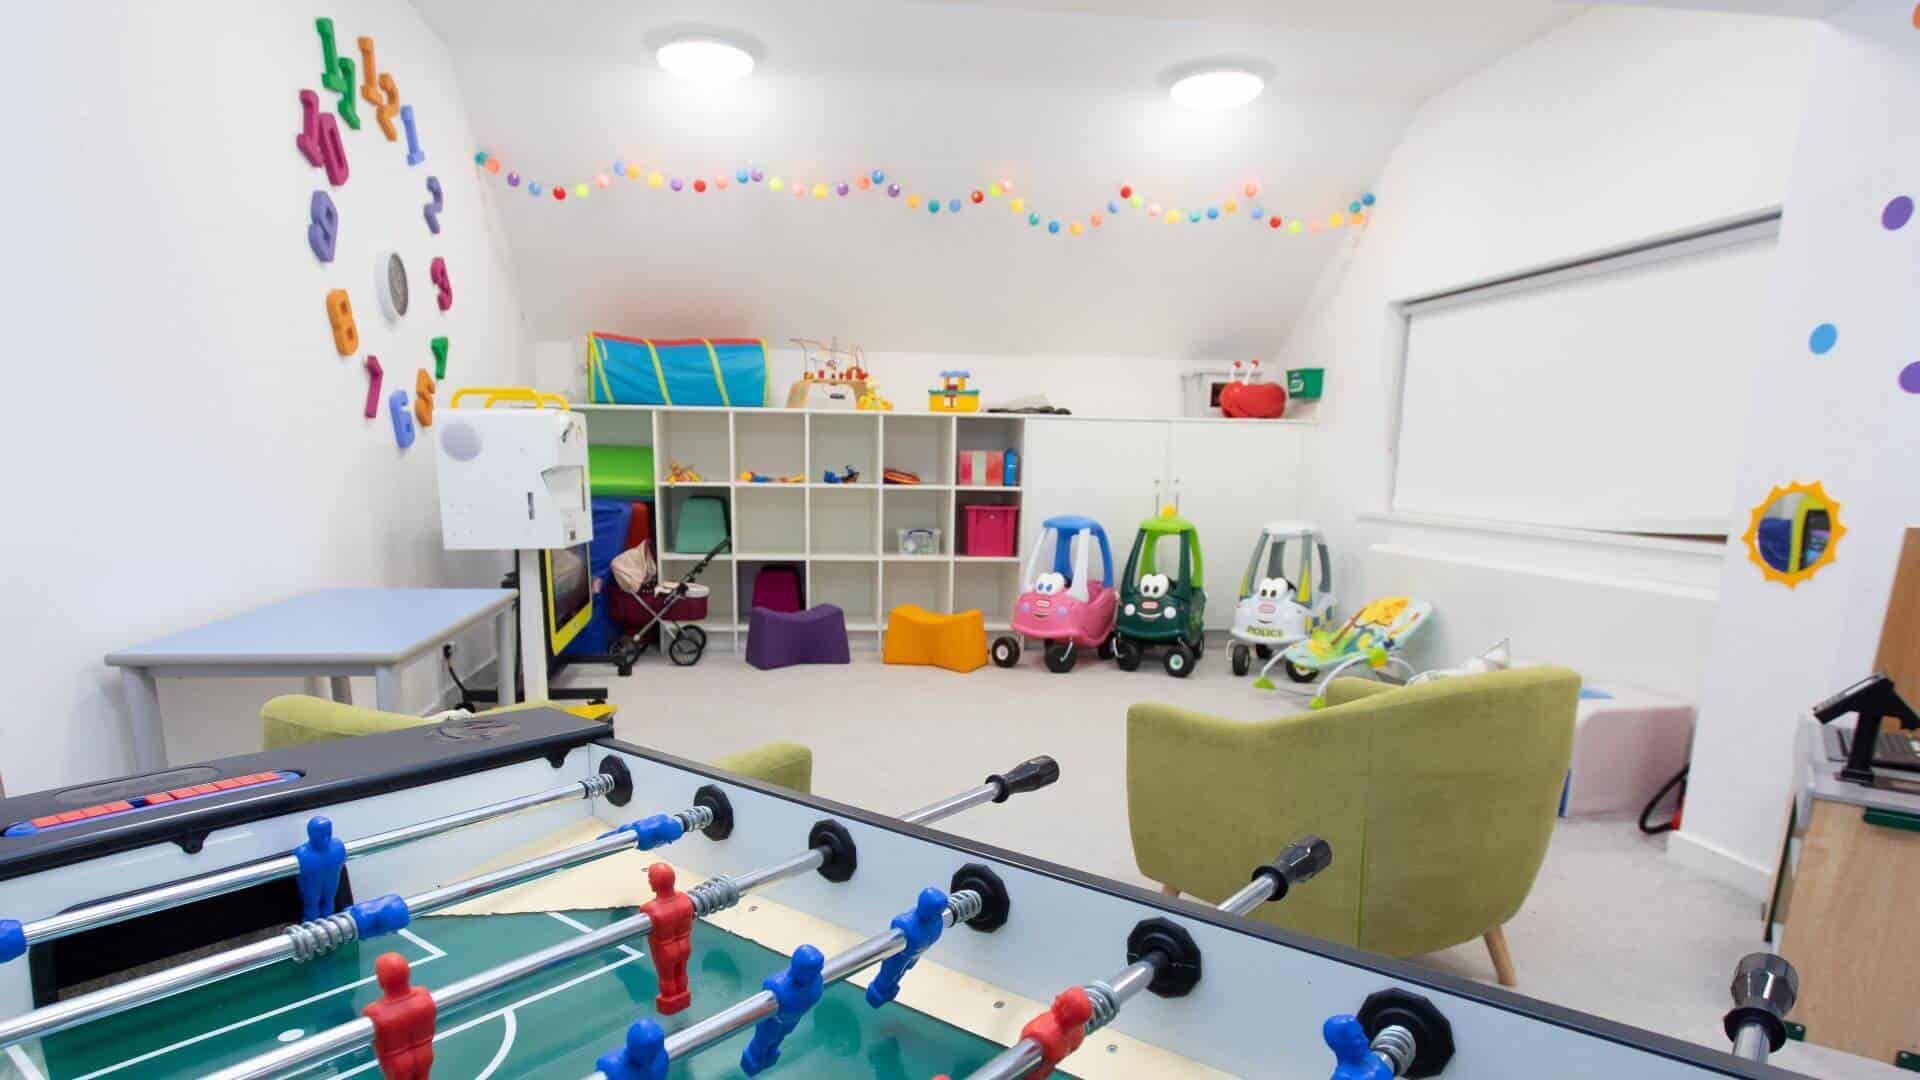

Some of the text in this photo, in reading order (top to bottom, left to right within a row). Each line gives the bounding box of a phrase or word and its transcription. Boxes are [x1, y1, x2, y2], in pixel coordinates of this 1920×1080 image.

[316, 17, 360, 130] 11
[357, 35, 399, 142] 12
[296, 89, 349, 186] 10
[401, 104, 425, 166] 1
[423, 176, 443, 234] 2
[326, 287, 359, 356] 8
[364, 355, 383, 418] 7
[389, 389, 415, 449] 6
